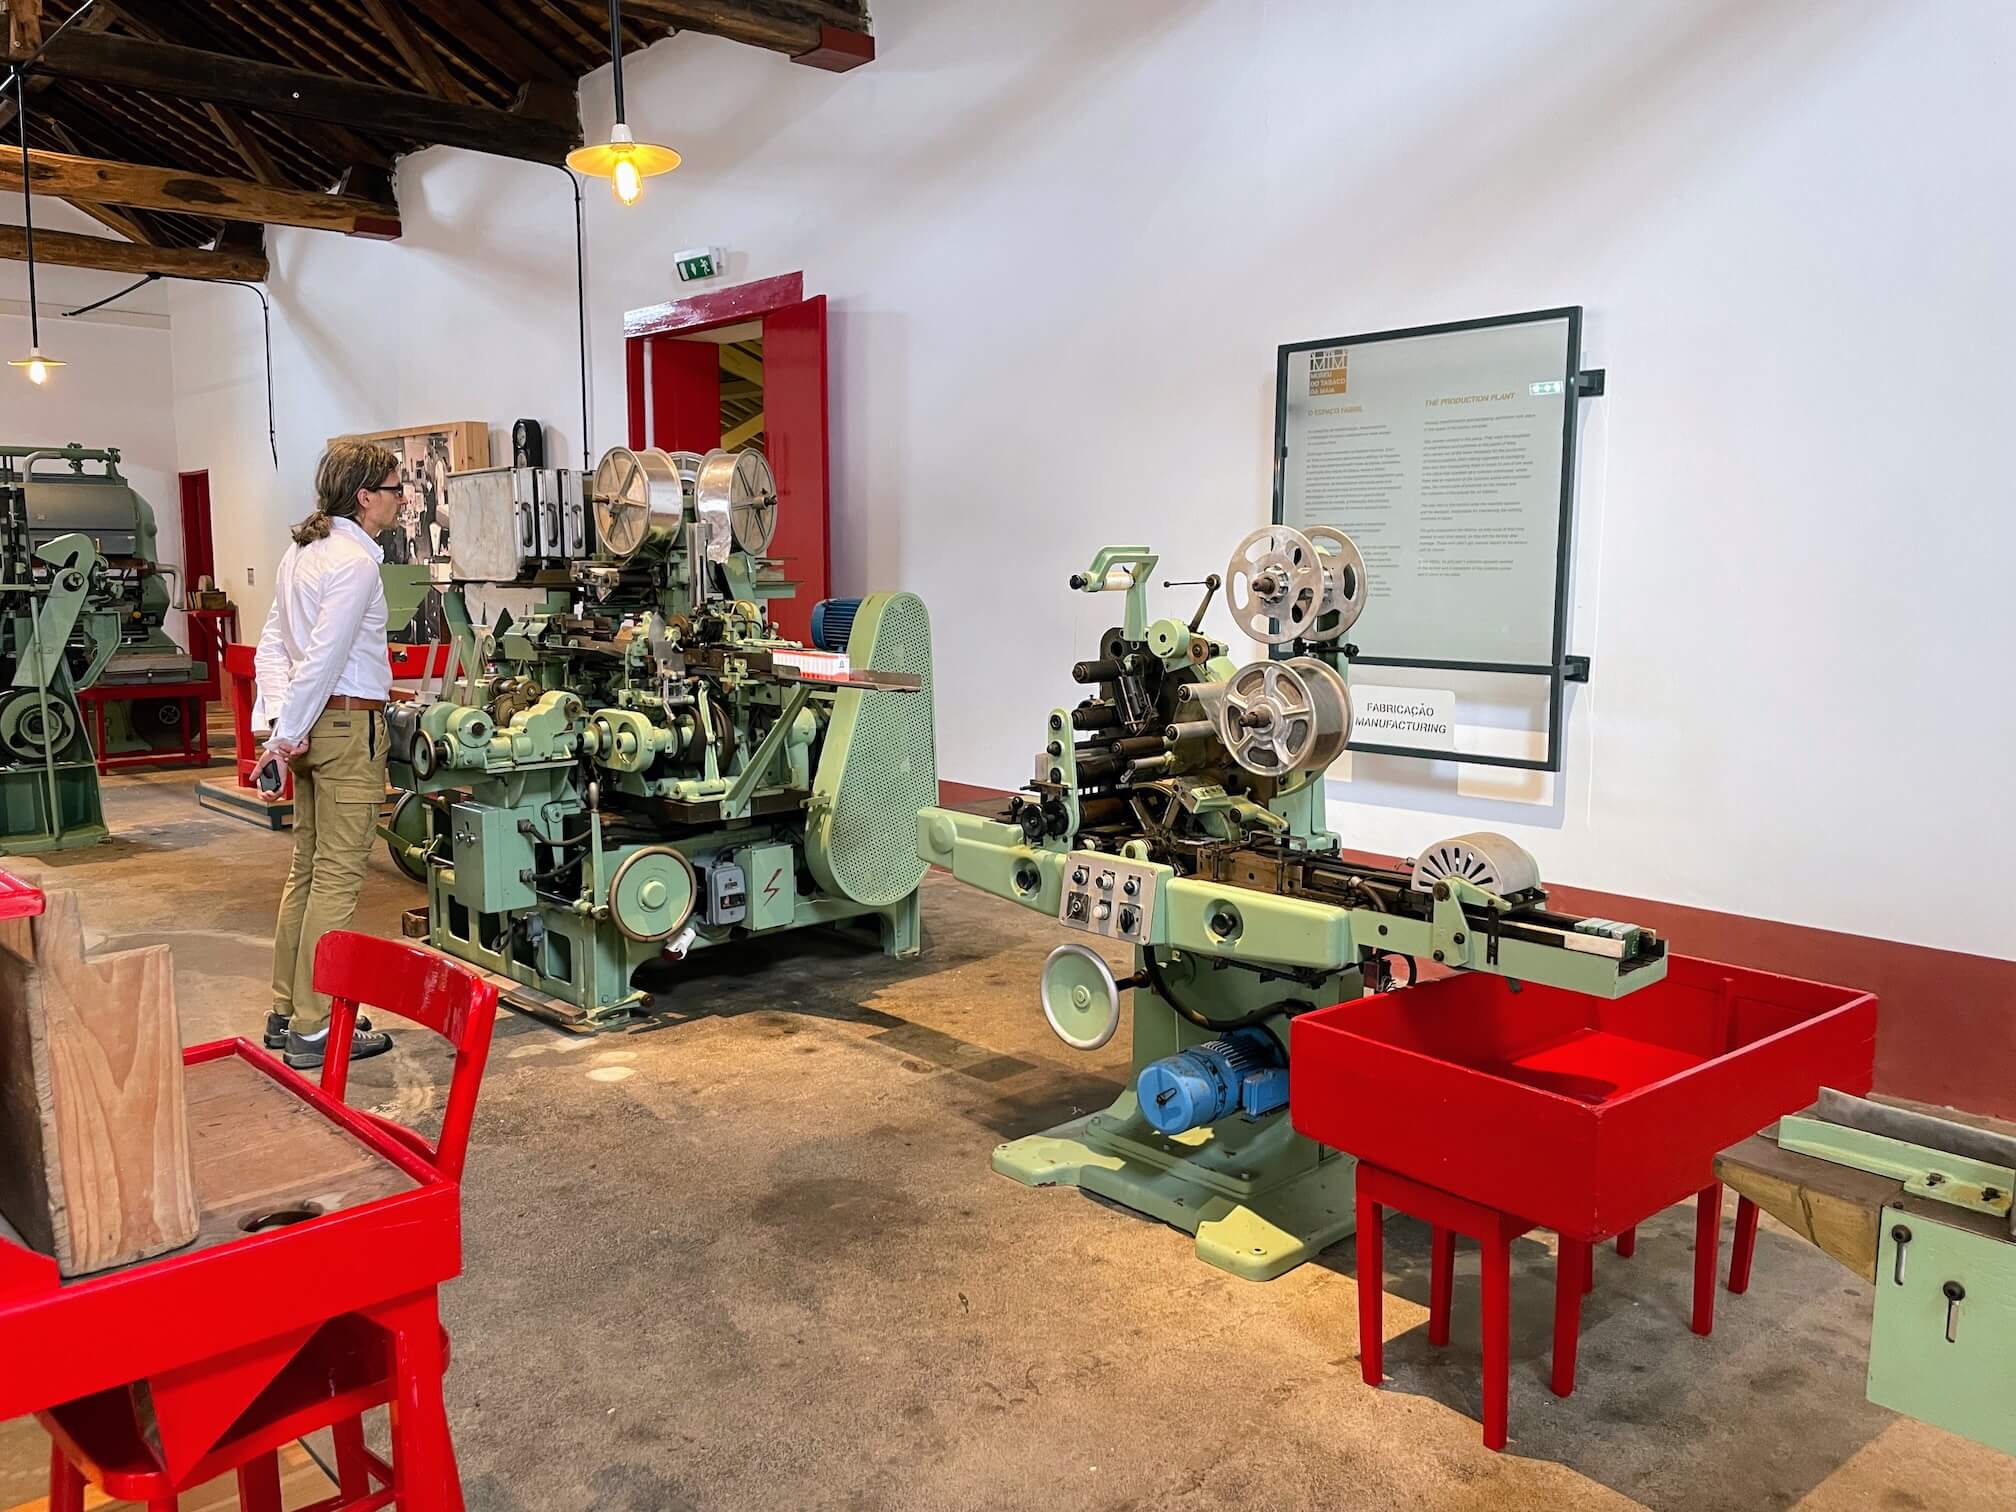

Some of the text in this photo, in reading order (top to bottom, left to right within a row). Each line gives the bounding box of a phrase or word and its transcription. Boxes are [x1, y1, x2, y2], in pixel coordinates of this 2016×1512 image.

[1425, 392, 1516, 407] THE PRODUCTION PLANT
[1366, 702, 1434, 718] FABRICAÇÃO
[1355, 718, 1447, 733] MANUFACTURING
